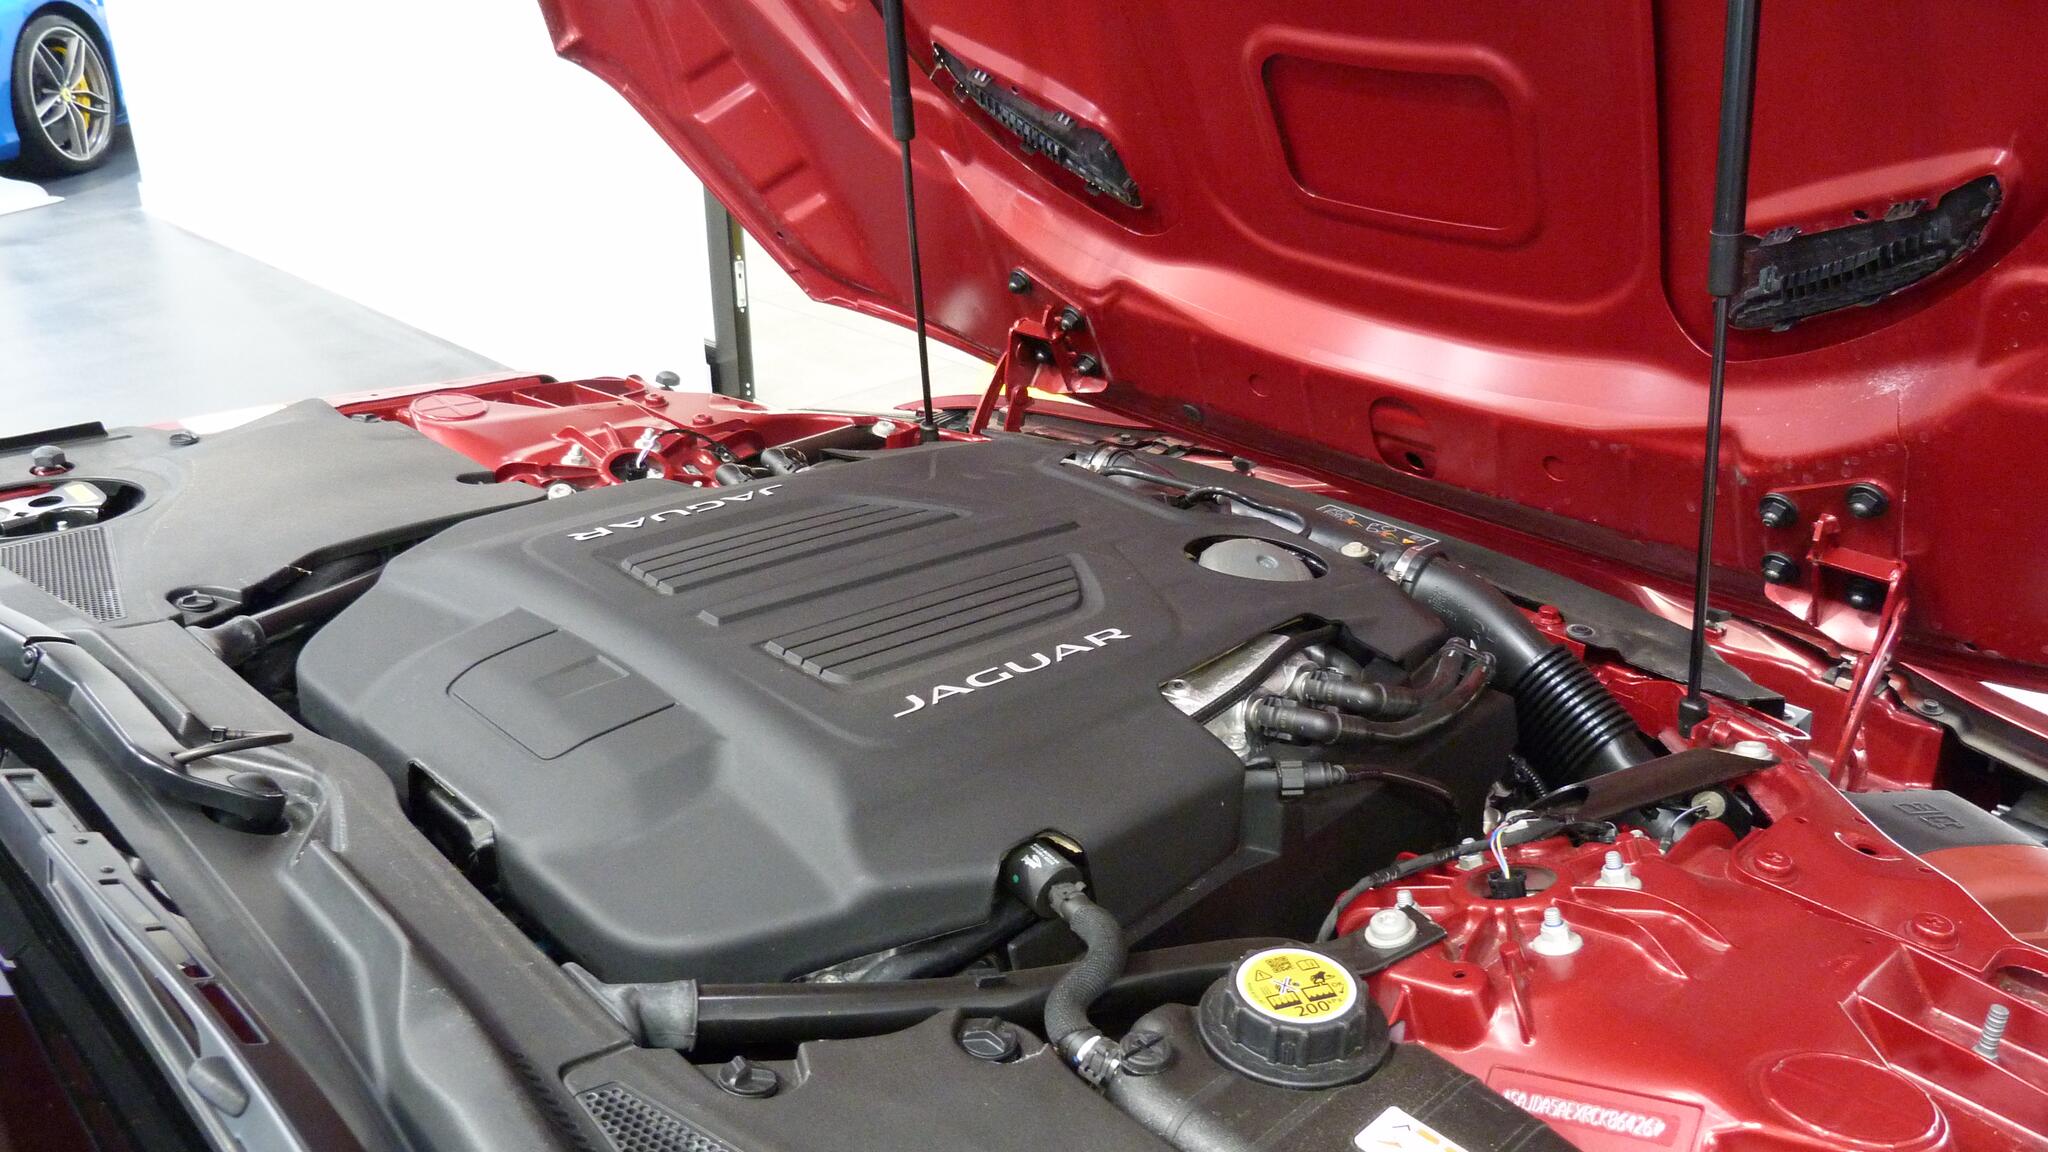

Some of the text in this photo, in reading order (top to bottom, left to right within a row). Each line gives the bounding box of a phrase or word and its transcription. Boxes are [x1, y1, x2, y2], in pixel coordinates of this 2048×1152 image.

[567, 484, 783, 541] JAGUAR
[893, 628, 1132, 718] JAGUAR
[1294, 1000, 1330, 1017] 200
